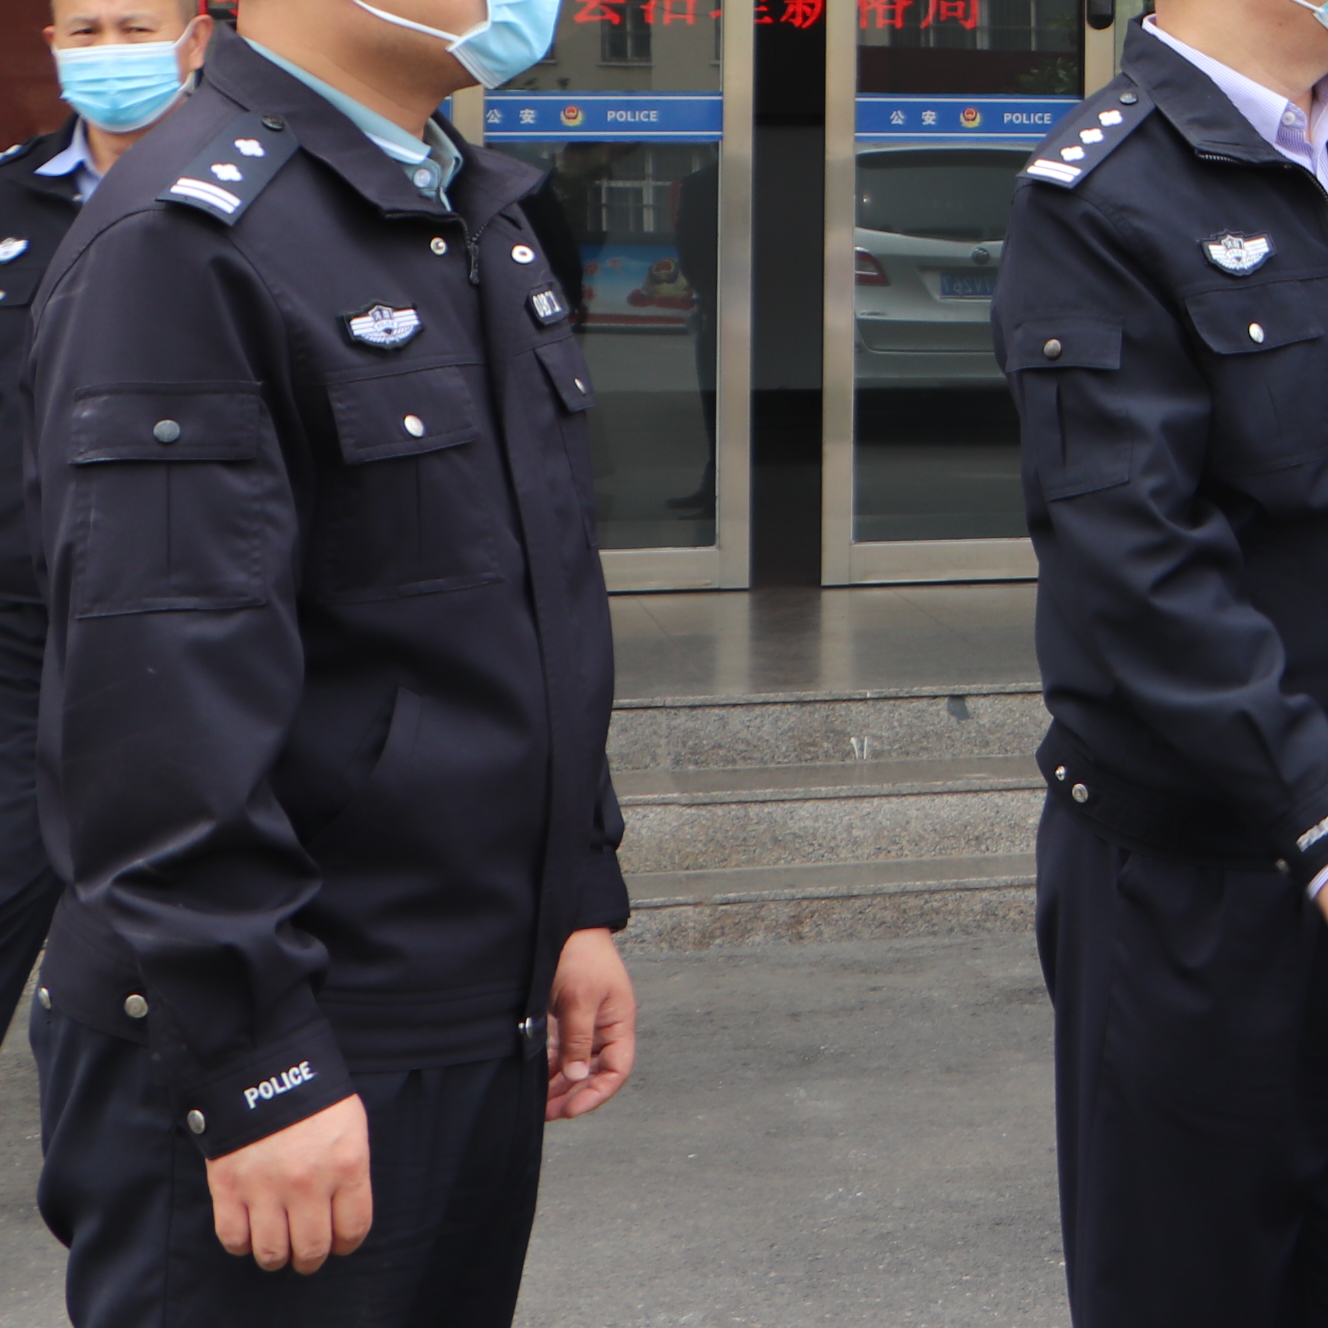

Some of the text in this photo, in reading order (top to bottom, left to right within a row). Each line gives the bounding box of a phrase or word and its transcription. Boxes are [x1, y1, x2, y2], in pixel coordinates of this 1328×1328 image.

[486, 108, 658, 124] 公安 POLICE
[890, 110, 1052, 126] 公安 POLICE
[243, 1060, 315, 1109] POLICE
